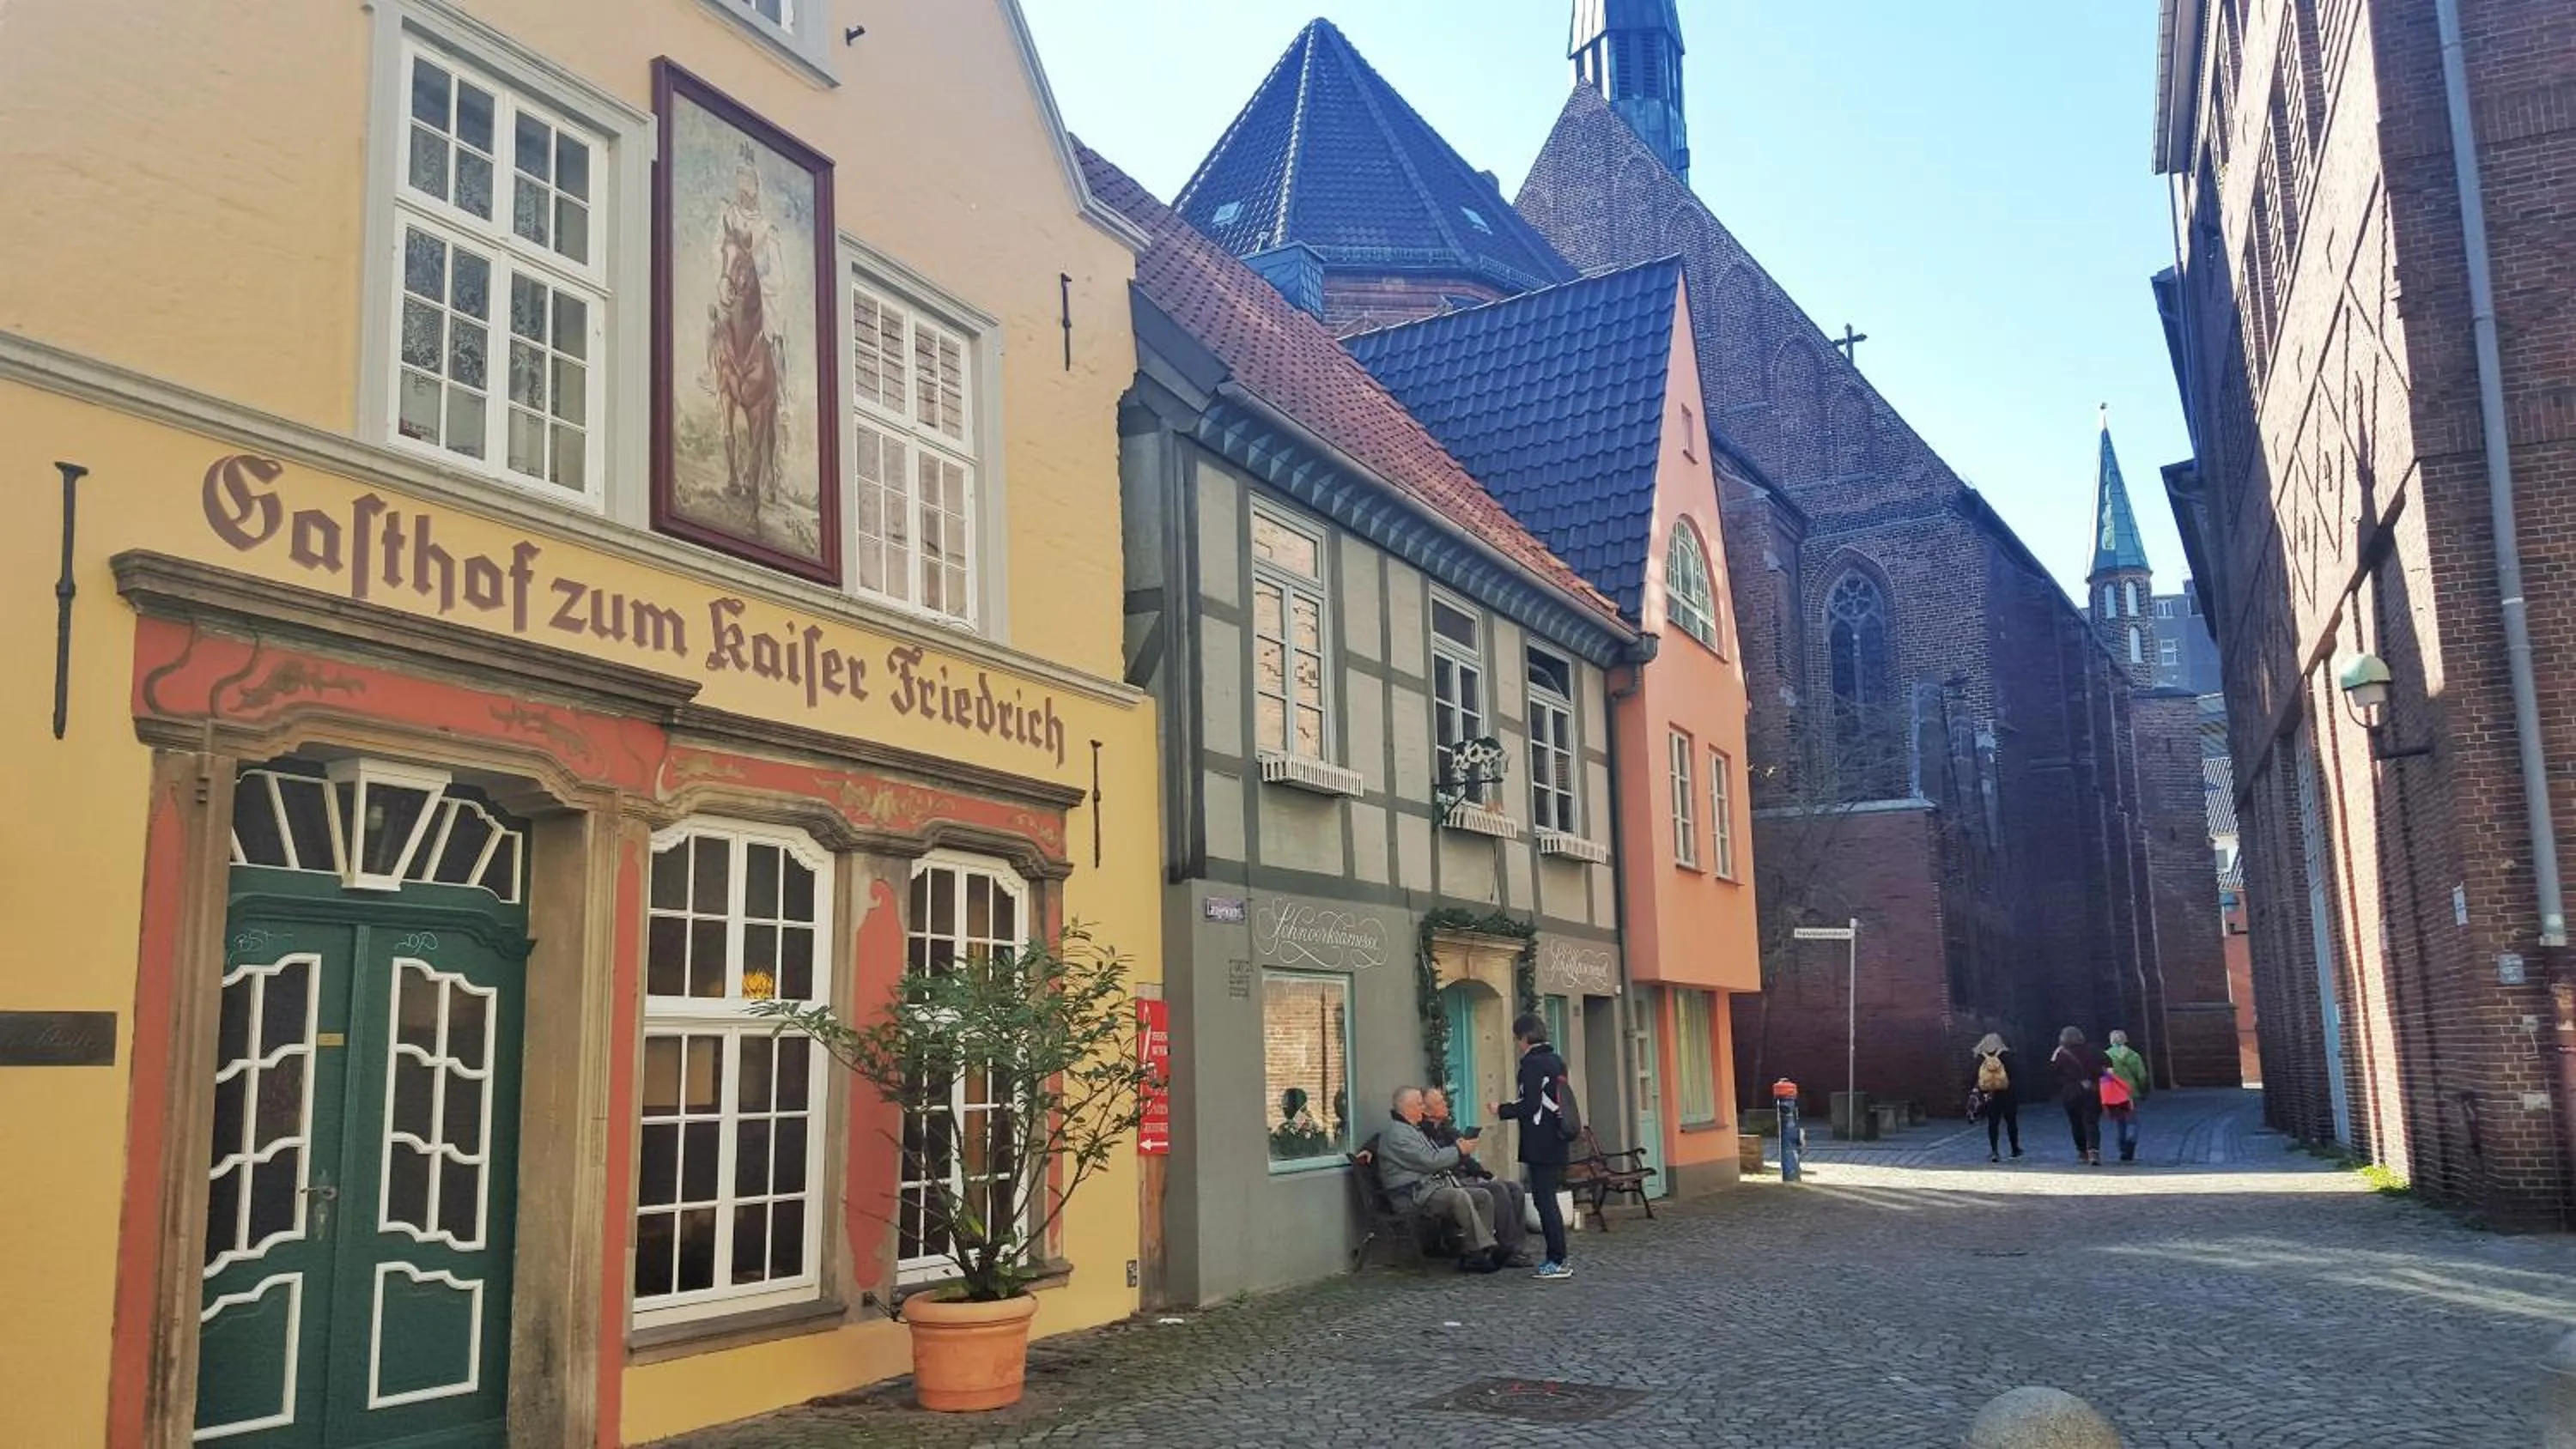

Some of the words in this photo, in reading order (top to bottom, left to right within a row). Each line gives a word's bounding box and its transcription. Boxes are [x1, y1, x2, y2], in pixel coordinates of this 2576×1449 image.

[550, 577, 689, 657] zum
[705, 597, 869, 708] Kaiser
[888, 646, 1066, 768] Friedrich
